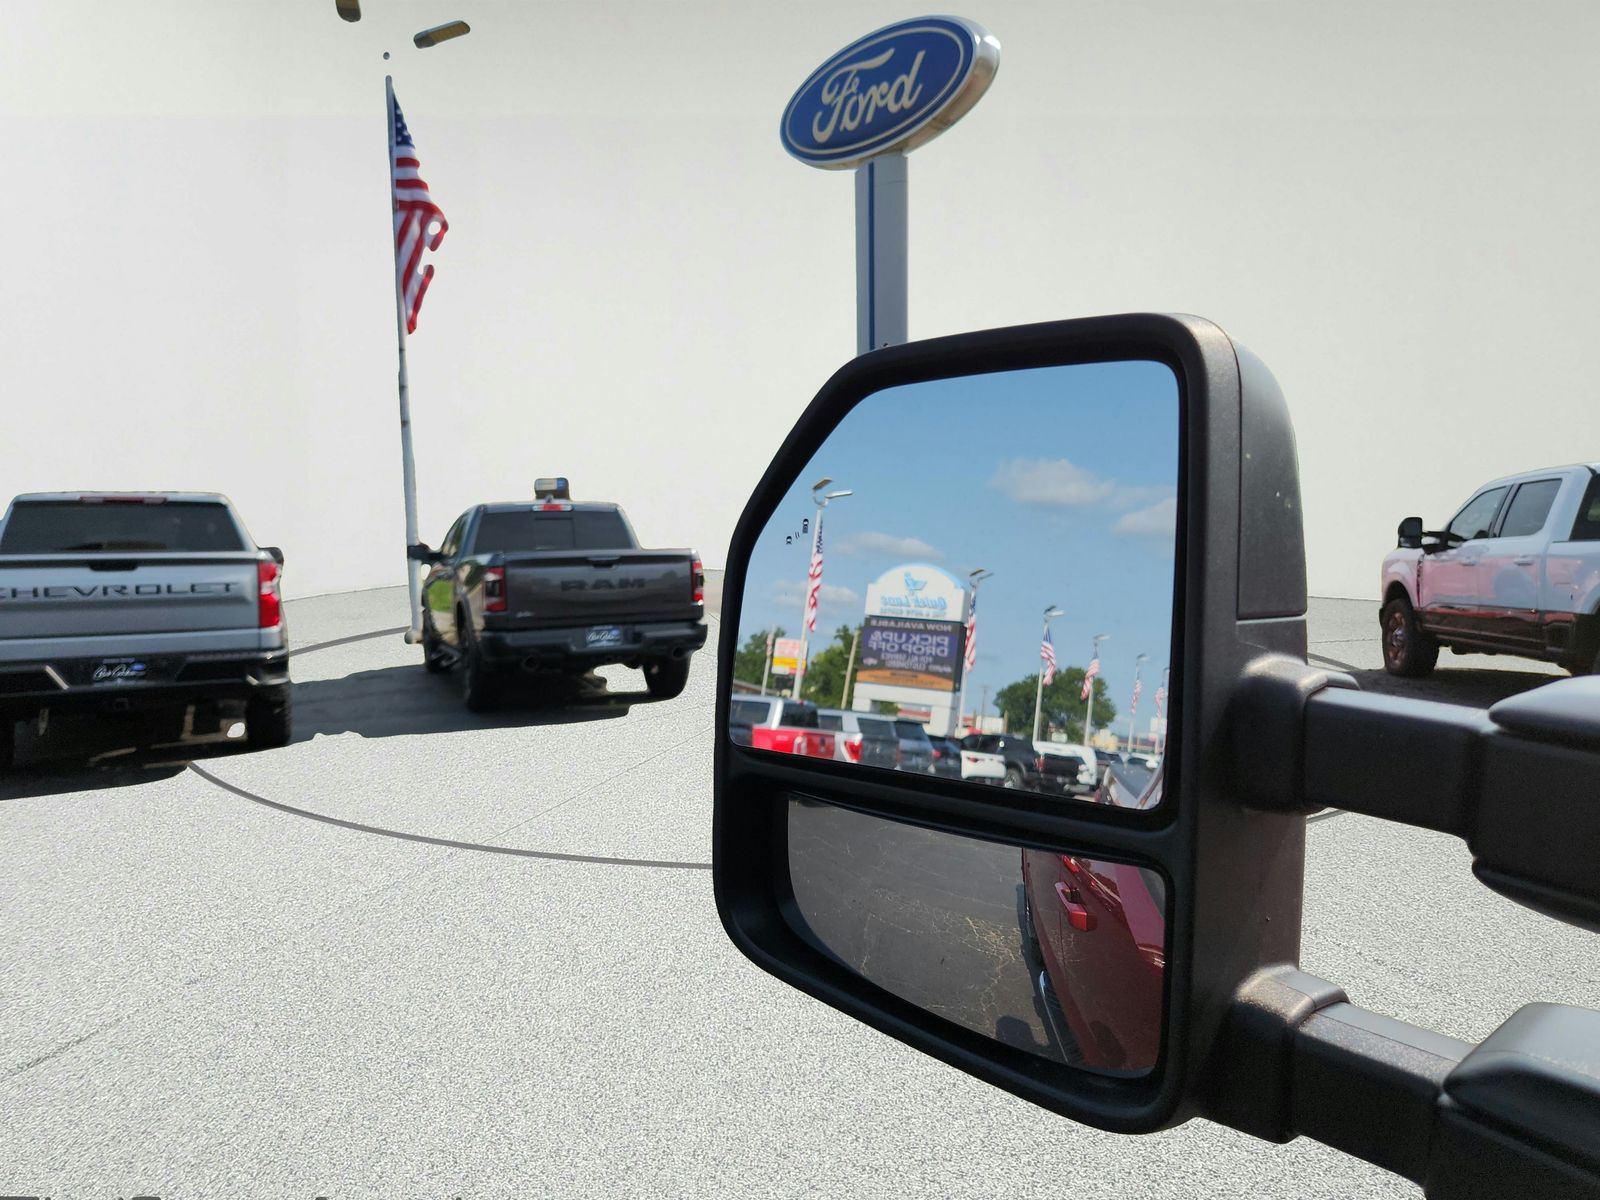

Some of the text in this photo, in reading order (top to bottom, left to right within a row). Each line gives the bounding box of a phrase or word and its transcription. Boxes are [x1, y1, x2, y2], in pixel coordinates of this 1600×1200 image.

[812, 48, 926, 143] Ford
[0, 582, 239, 598] HEVROLET
[560, 578, 645, 591] RAM
